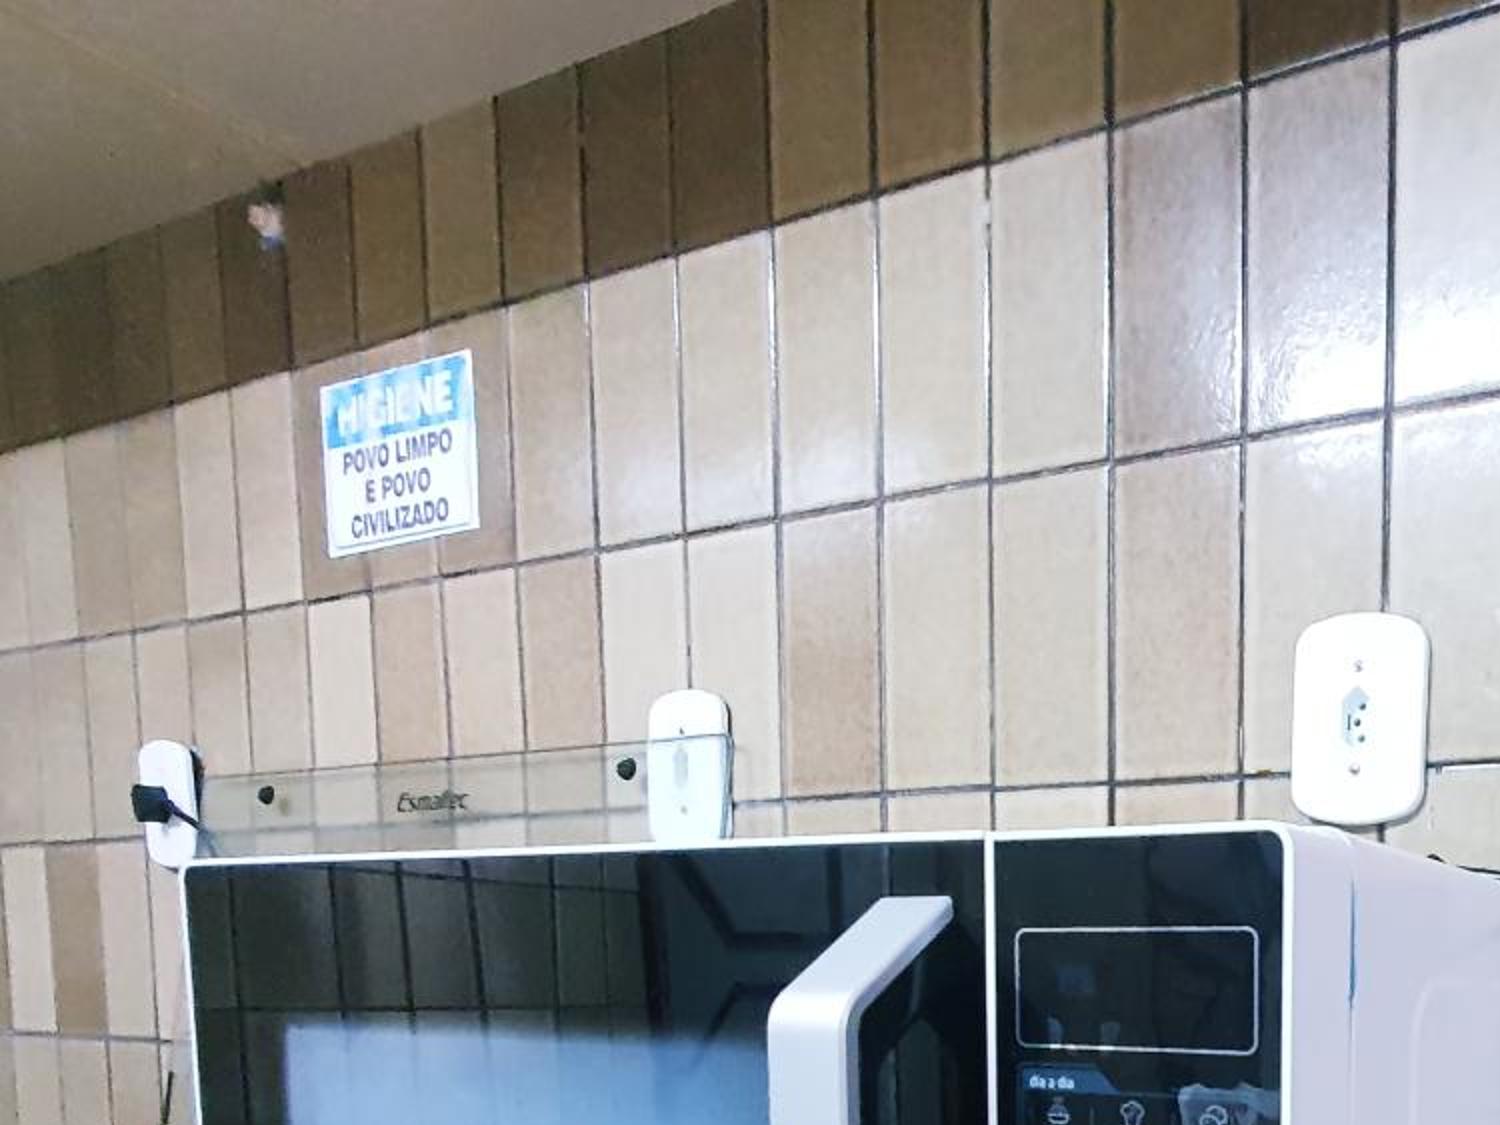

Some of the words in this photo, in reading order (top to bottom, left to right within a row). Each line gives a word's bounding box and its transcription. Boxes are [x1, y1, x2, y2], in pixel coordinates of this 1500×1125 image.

[342, 443, 390, 476] POVO
[395, 428, 453, 463] LIMPO
[365, 479, 376, 502] E
[381, 467, 432, 500] POVO
[351, 496, 450, 539] CIVILIZADO
